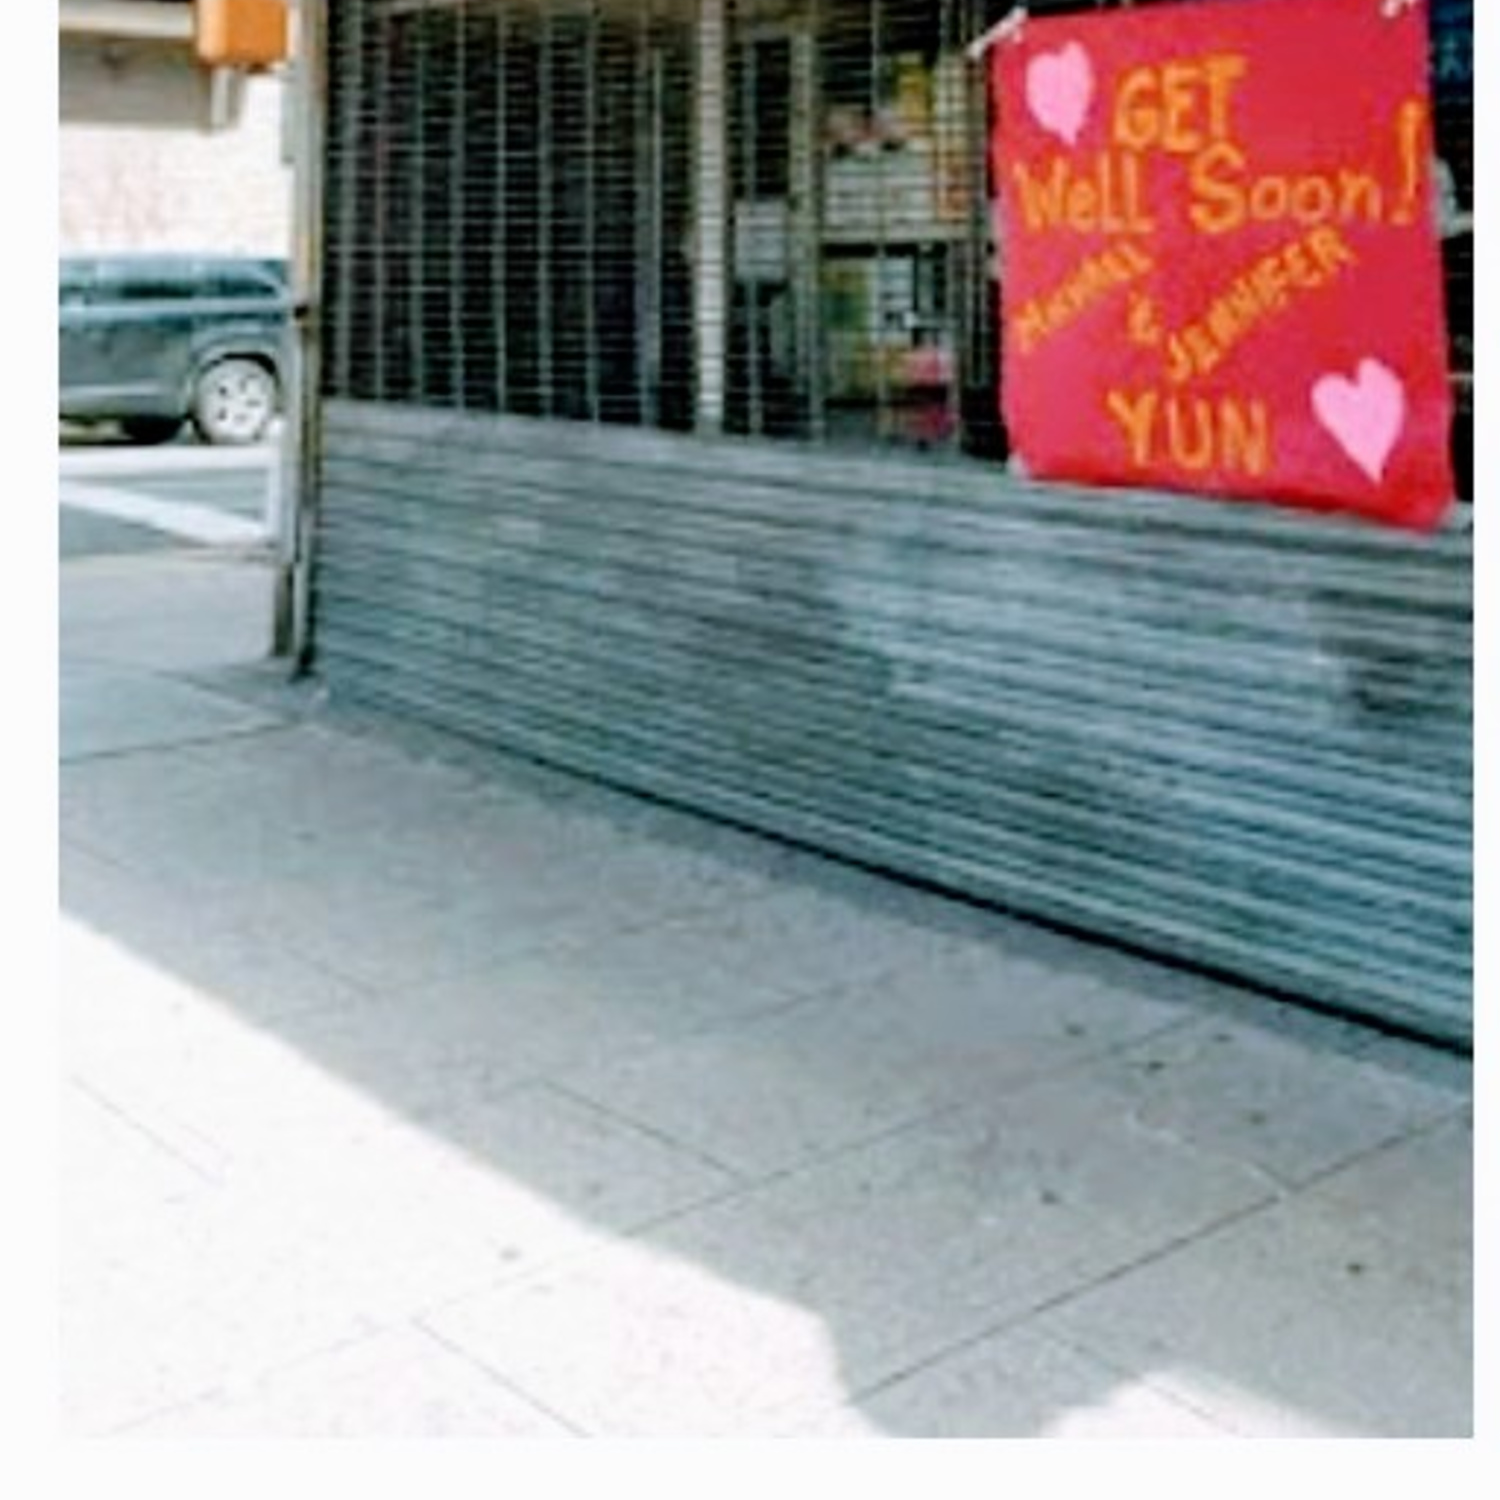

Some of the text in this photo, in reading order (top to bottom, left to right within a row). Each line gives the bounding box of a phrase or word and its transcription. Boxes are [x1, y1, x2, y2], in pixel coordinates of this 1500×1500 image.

[1112, 53, 1246, 153] GET
[1188, 100, 1428, 236] Soon!
[1106, 390, 1270, 477] YUN
